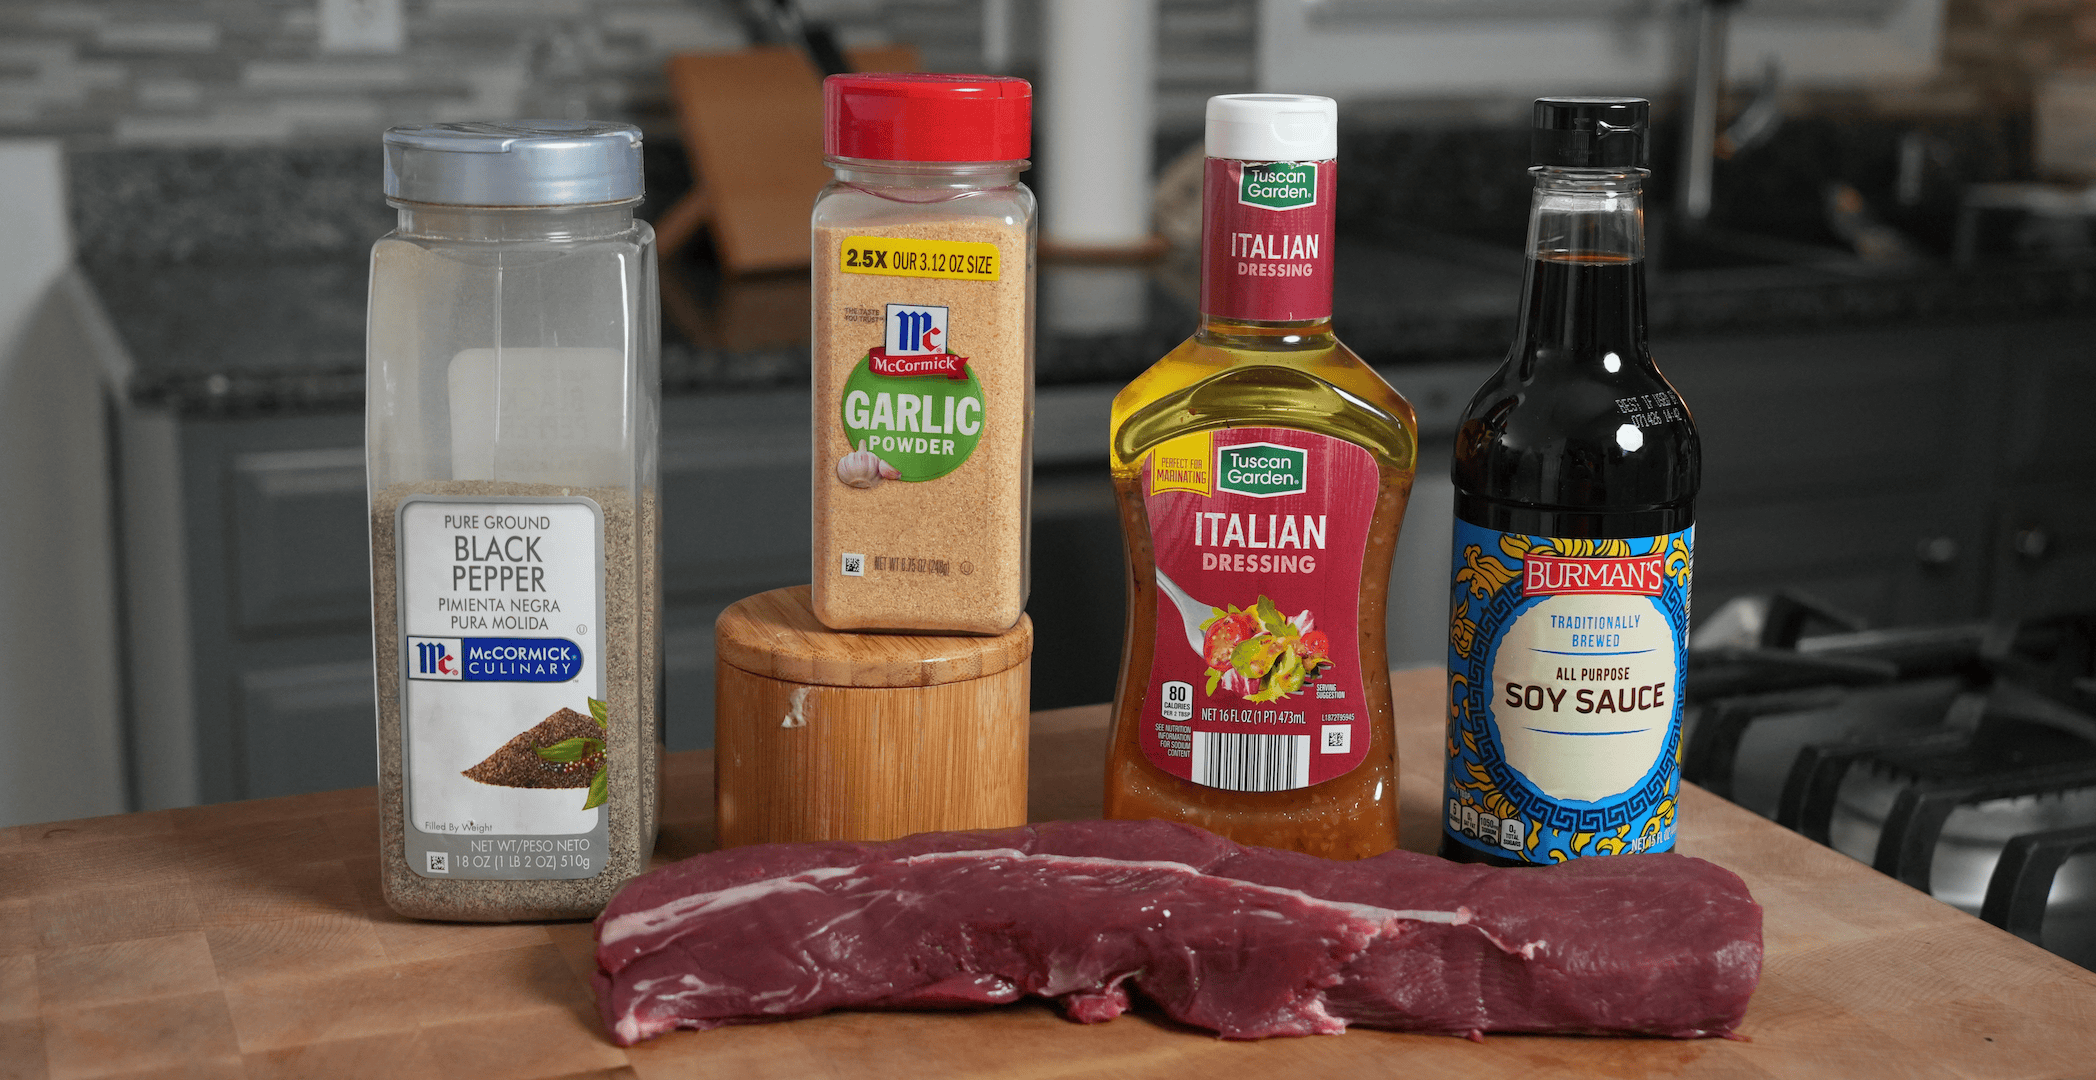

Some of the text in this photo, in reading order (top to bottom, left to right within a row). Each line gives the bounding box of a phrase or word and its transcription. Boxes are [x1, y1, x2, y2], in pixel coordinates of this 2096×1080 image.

[1251, 169, 1306, 183] Tuscan
[1247, 183, 1309, 199] Garden
[1231, 232, 1319, 260] ITALIAN
[846, 248, 993, 274] 2.5X OUR 3.12 OZ SIZE
[1237, 262, 1313, 277] DRESSING
[859, 308, 880, 316] TASTE
[873, 356, 957, 373] McCormick
[1615, 397, 1642, 413] BEST
[1641, 395, 1653, 409] IF
[845, 389, 981, 436] GARLIC
[869, 435, 955, 456] POWDER
[1161, 457, 1203, 470] PERFECT FOR
[1230, 453, 1292, 469] Tuscan
[1157, 469, 1207, 484] MARINATING
[1227, 469, 1294, 486] Garden
[444, 515, 550, 530] PURE GROUND
[1194, 511, 1327, 550] ITALIAN
[454, 535, 543, 563] BLACK
[874, 556, 887, 571] NET
[889, 557, 899, 572] WT
[917, 558, 926, 573] OZ
[1202, 552, 1316, 574] DRESSING
[453, 565, 546, 592] PEPPER
[1526, 559, 1662, 591] BURMAN'S
[438, 597, 561, 613] PIMIENTA NEGRA
[451, 616, 549, 630] PURA MOLIDA
[1550, 614, 1641, 629] TRADITIONALLY
[1572, 634, 1620, 648] BREWED
[469, 646, 571, 661] McCORMICK
[469, 662, 571, 675] CULINARY
[1556, 667, 1630, 681] ALL PURPOSE
[1169, 685, 1186, 702] 80
[1316, 691, 1346, 699] SUGGESTION
[1505, 681, 1666, 715] SOY SAUCE
[1164, 701, 1191, 710] CALORIES
[1201, 708, 1306, 725] NET 16 FL OZ (1 PT) 473mL
[1155, 723, 1192, 734] SEE NUTRITION
[1158, 731, 1191, 742] INFORMATION
[1160, 740, 1191, 750] FOR SODIUM
[1167, 748, 1191, 758] CONTENT
[425, 821, 493, 833] Filled By Weight
[471, 838, 590, 854] NET WT/PESO NETO
[1503, 839, 1521, 847] SUGARS
[1632, 836, 1646, 851] NET
[456, 854, 590, 871] 18 OZ (1 LB 2 OZ) 510g
